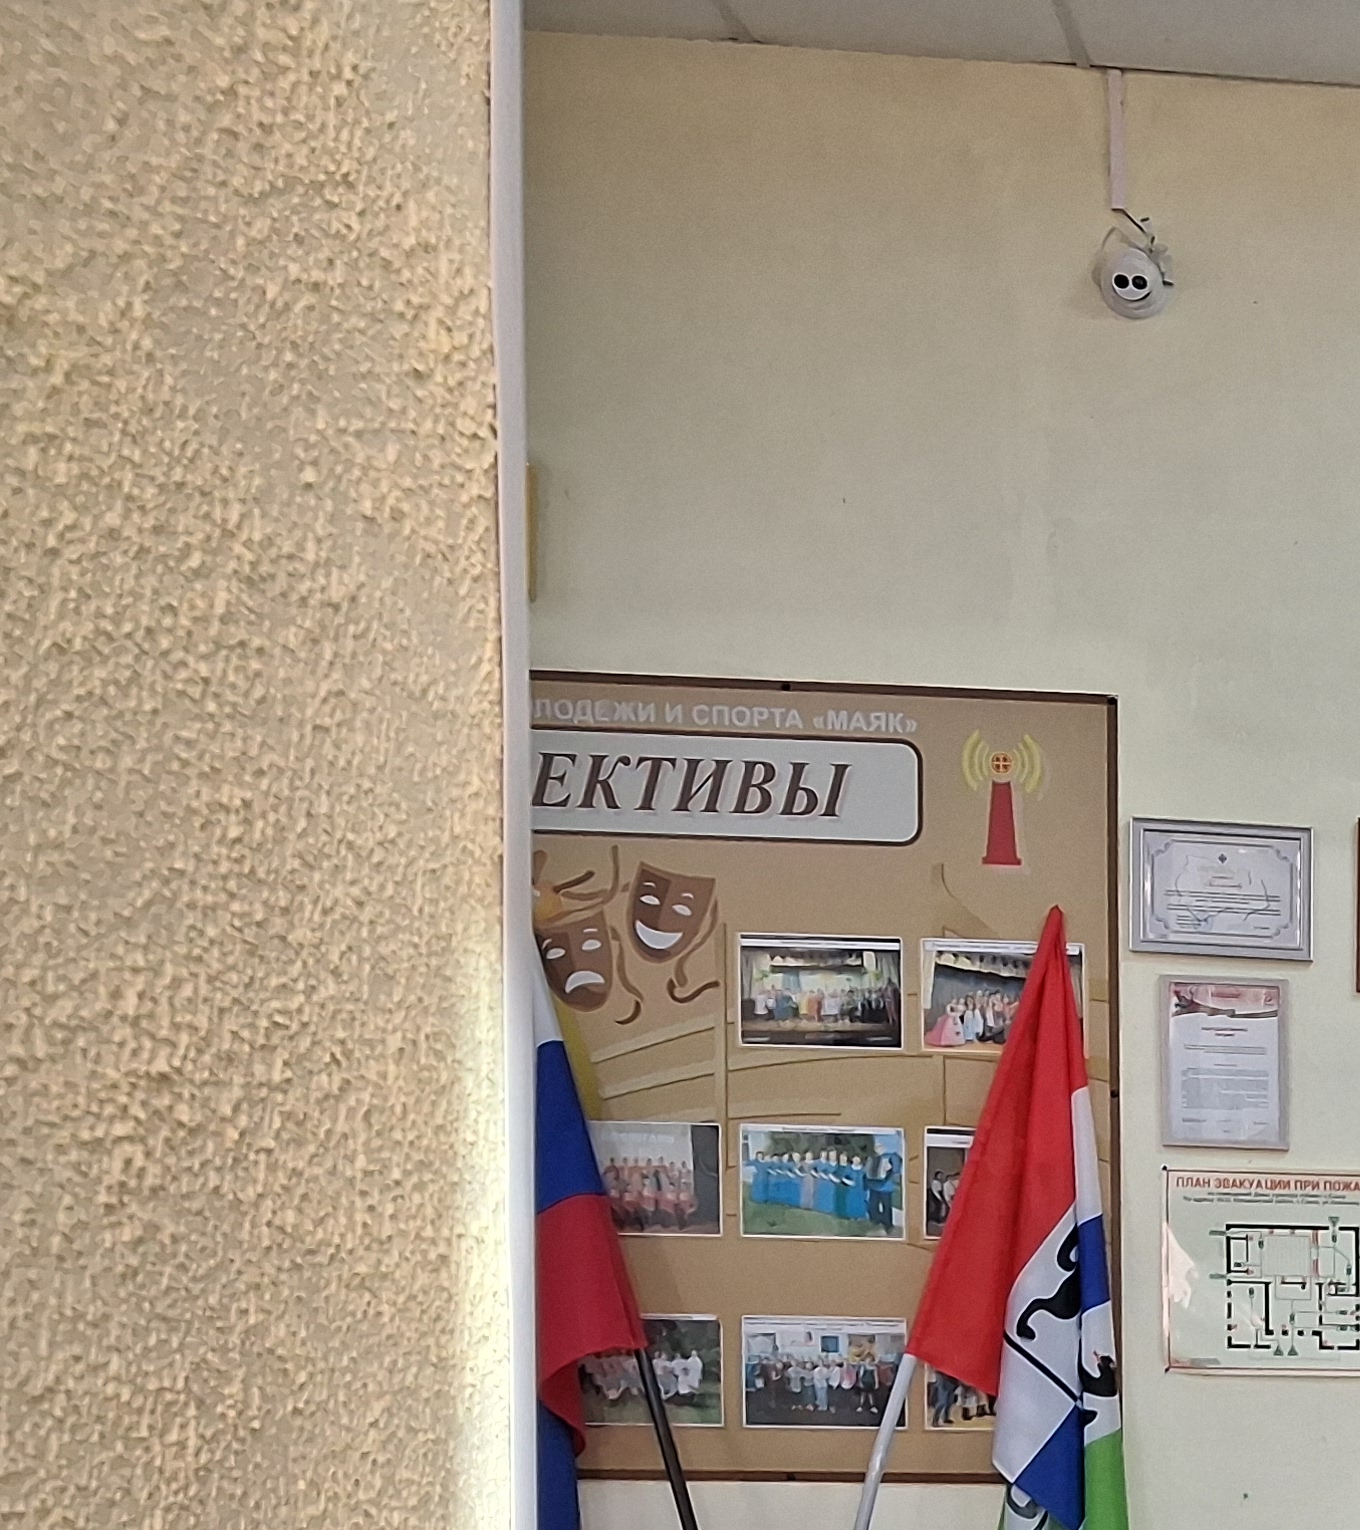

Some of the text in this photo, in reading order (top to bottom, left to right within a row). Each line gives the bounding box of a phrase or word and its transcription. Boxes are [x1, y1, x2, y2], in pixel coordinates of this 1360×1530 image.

[531, 699, 919, 734] ЛОДЕЖИ И СПОРТА «МАЯК»
[531, 750, 853, 819] ЕКТИВЫ
[1176, 1176, 1211, 1189] ПЛАН
[1214, 1178, 1291, 1191] ЭВАКУАЦИИ
[1294, 1180, 1320, 1191] ПРИ
